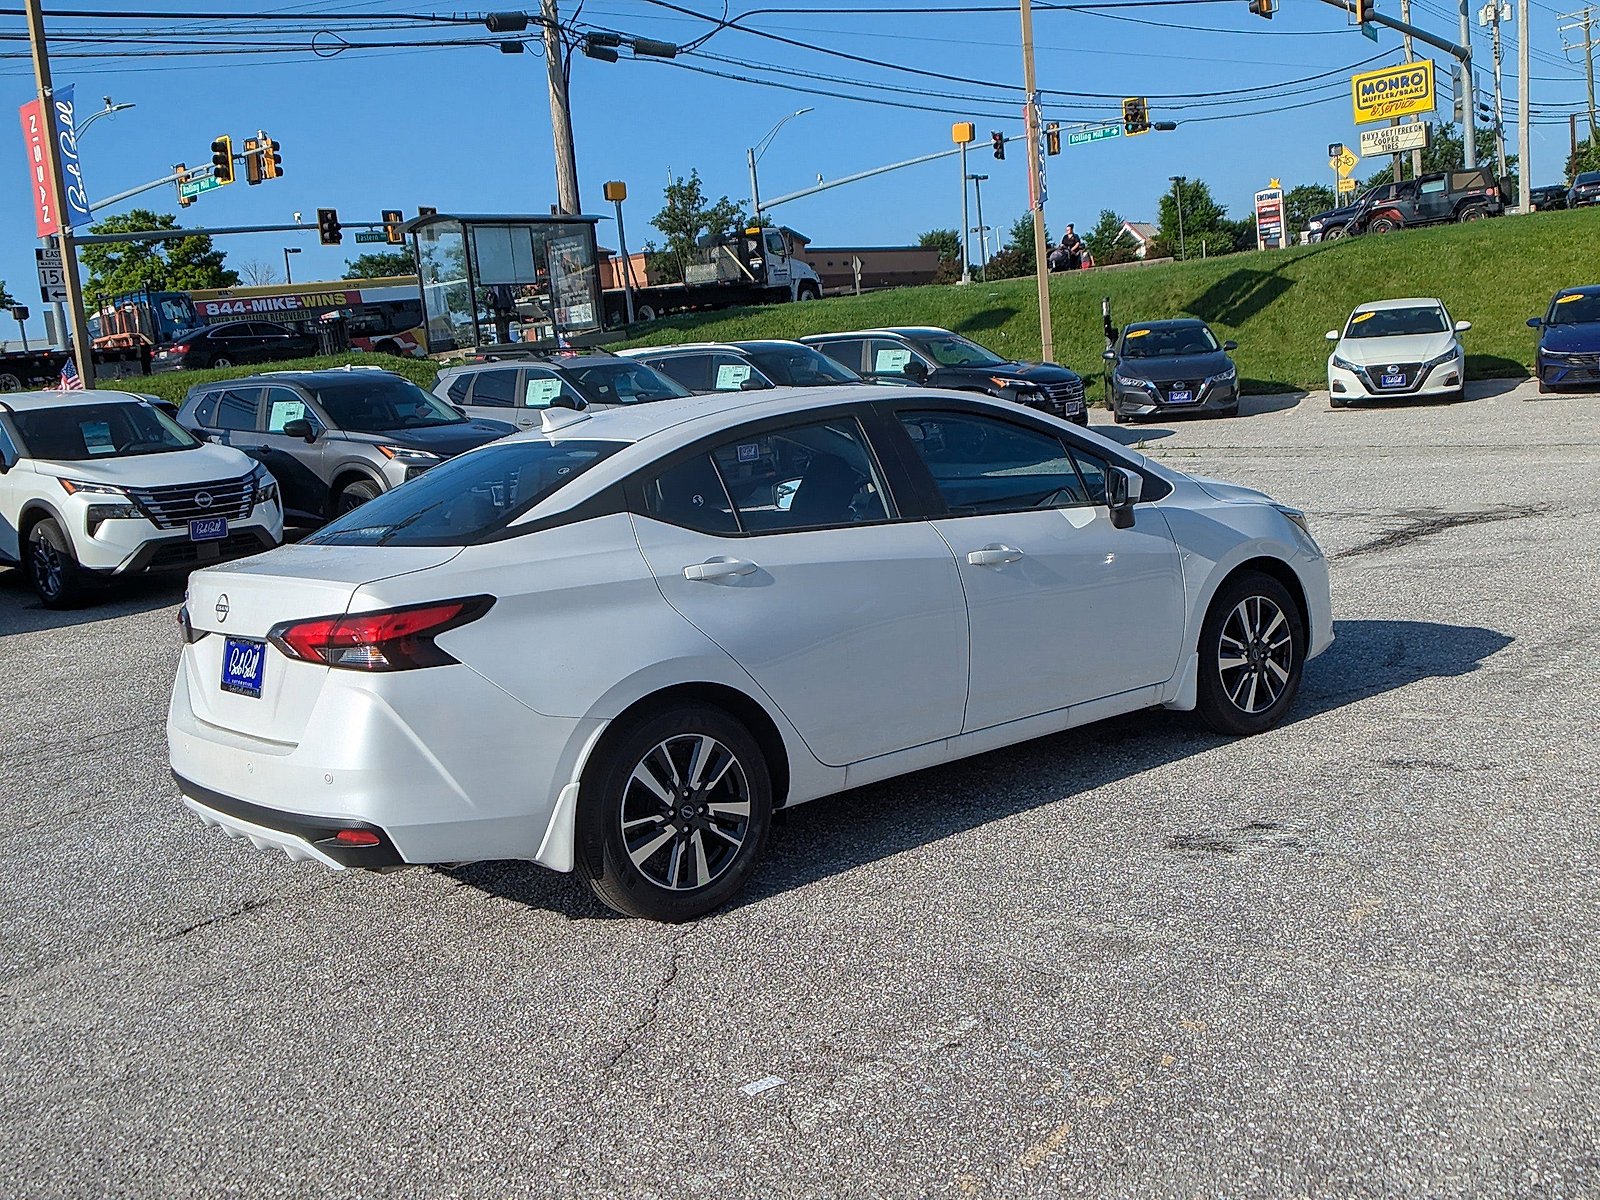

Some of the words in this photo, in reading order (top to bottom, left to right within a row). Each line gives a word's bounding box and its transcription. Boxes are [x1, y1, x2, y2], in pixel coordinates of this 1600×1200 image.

[1361, 72, 1424, 97] MONRO
[1362, 86, 1424, 104] MUFFLER/BRAKE
[1071, 131, 1092, 143] Rolling
[1092, 130, 1104, 140] Mill
[1373, 135, 1400, 146] COOPER
[1381, 142, 1399, 151] TIRES
[28, 114, 51, 224] NISSAN
[206, 293, 347, 315] 844-MIKE-WINS
[268, 310, 311, 322] RECOVERED
